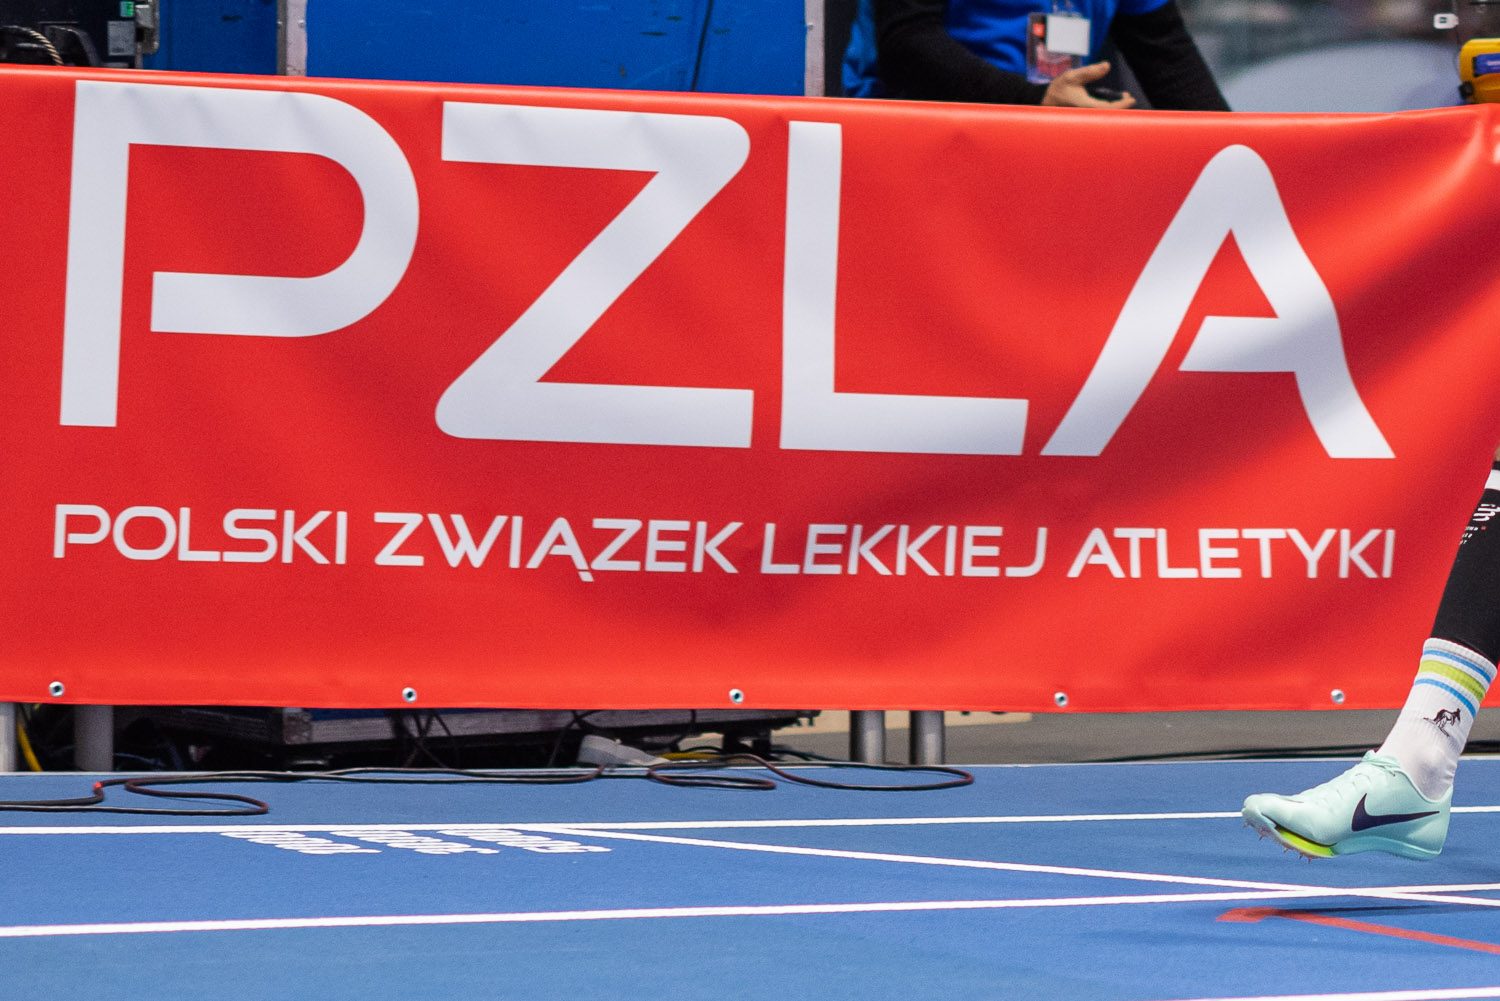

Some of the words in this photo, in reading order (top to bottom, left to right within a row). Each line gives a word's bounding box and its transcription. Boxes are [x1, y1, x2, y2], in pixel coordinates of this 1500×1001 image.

[59, 80, 1396, 459] PZLA
[53, 503, 348, 565] POLSKI
[373, 511, 743, 584] ZWIĄZEK
[761, 522, 1048, 578] LEKKIEJ
[1067, 527, 1395, 579] ATLETYKI
